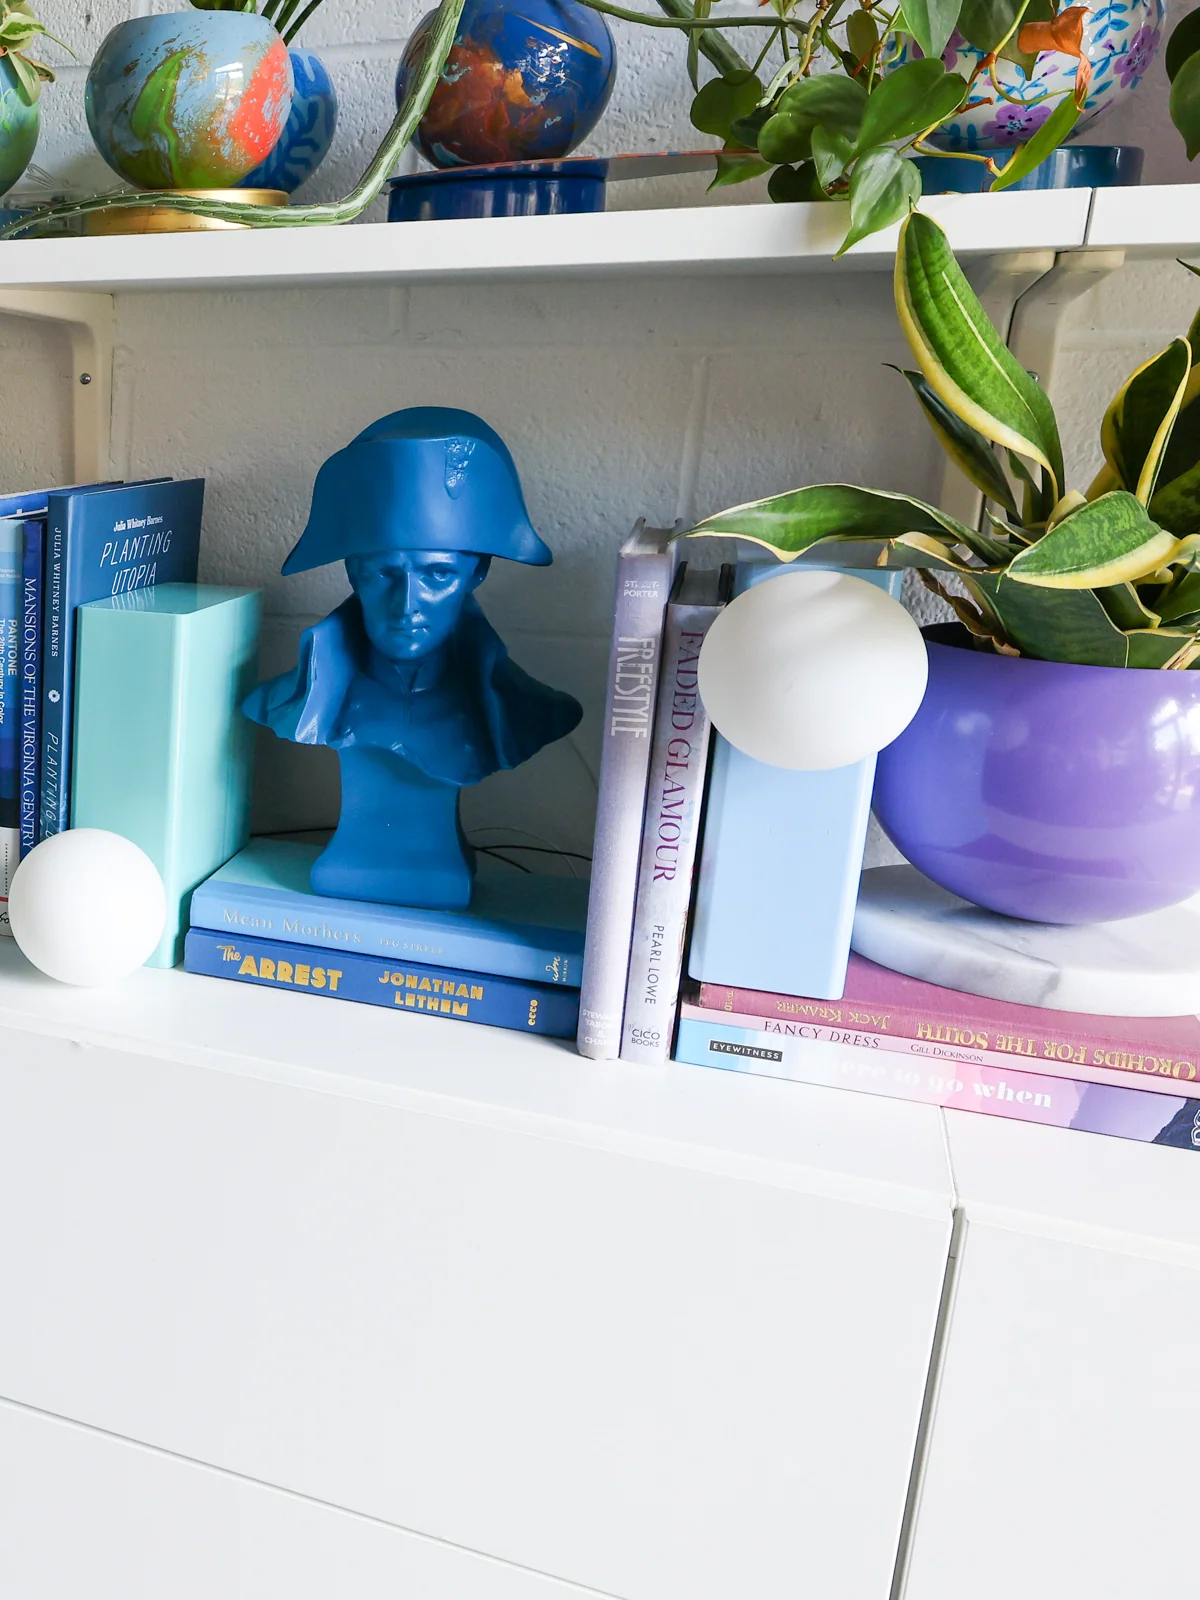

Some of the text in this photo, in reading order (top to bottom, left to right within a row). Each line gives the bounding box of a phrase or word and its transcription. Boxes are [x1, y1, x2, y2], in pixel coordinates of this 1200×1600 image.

[113, 515, 163, 532] Julia Whitney Barnes
[99, 530, 173, 568] PLANTING
[51, 527, 62, 657] JULIA WHITNEY BARNES
[111, 562, 157, 595] UTOPIA
[623, 590, 659, 598] PORTER
[7, 619, 18, 676] PANTONE
[610, 636, 656, 739] FREESTYLE
[22, 578, 37, 850] MANSIONS OF THE VIRGINIA GENTRY
[652, 631, 704, 883] FADED GLAMOUR
[45, 731, 59, 821] PLANTING
[222, 909, 363, 944] Mean Mothers
[403, 942, 445, 955] STREEP
[644, 924, 665, 1005] PEARL LOWE
[216, 945, 343, 992] The ARREST
[378, 970, 485, 1000] JONATHAN
[394, 991, 469, 1017] LETHEM
[776, 1000, 891, 1030] JACK KRAMER
[631, 1038, 660, 1048] BOOKS
[632, 1029, 661, 1041] CICO
[712, 1042, 780, 1060] EYEWITNESS
[763, 1021, 881, 1049] FANCY DRESS
[916, 1022, 1198, 1081] ORCHIDS FOR THE SOUTH
[838, 1059, 1053, 1109] ere to go when
